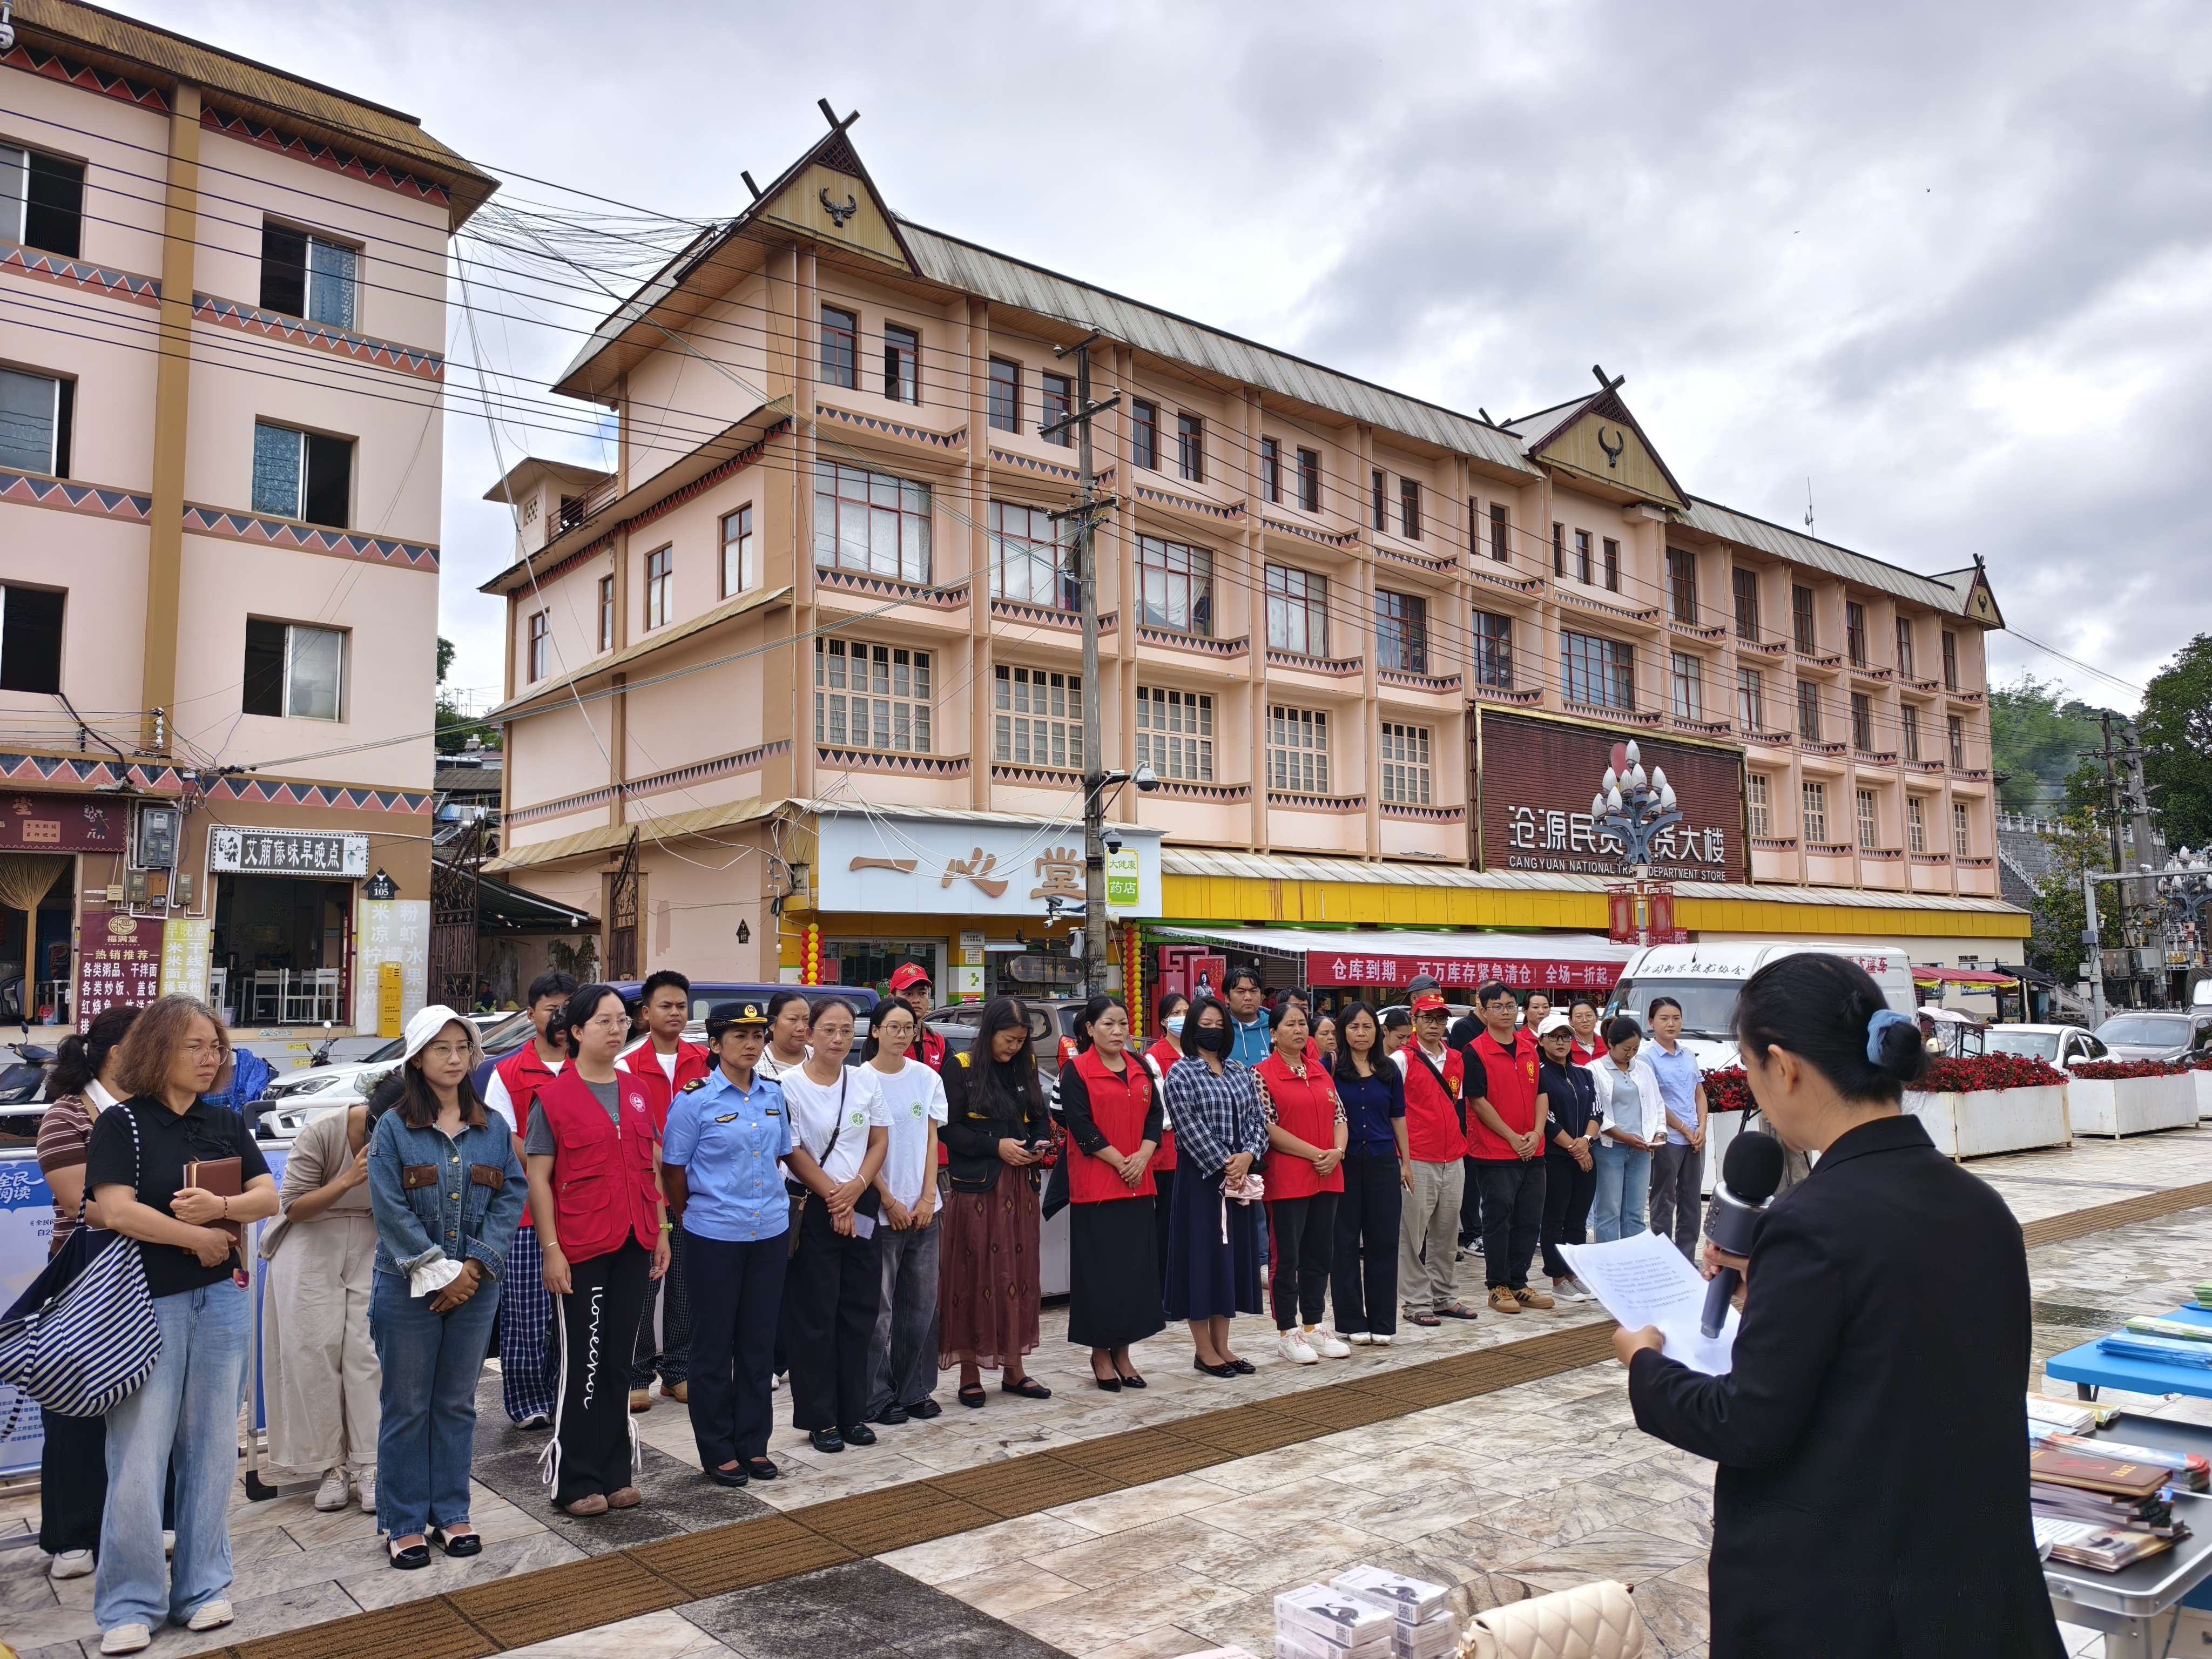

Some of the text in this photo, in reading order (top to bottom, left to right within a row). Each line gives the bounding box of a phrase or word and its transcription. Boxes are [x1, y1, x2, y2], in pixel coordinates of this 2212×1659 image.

[1109, 859, 1137, 869] 大健康
[1569, 861, 1615, 874] NATIONAL
[1648, 866, 1698, 880] DEPARTMENT
[1701, 870, 1726, 881] STORE
[848, 847, 1085, 899] 一心堂
[374, 888, 389, 896] 105
[1109, 881, 1137, 894] 药店
[166, 922, 207, 937] 早晚点
[96, 949, 149, 960] 热销推荐
[363, 946, 423, 965] 柠檬水
[164, 981, 202, 993] 稀豆粉
[0, 1171, 44, 1188] 全民
